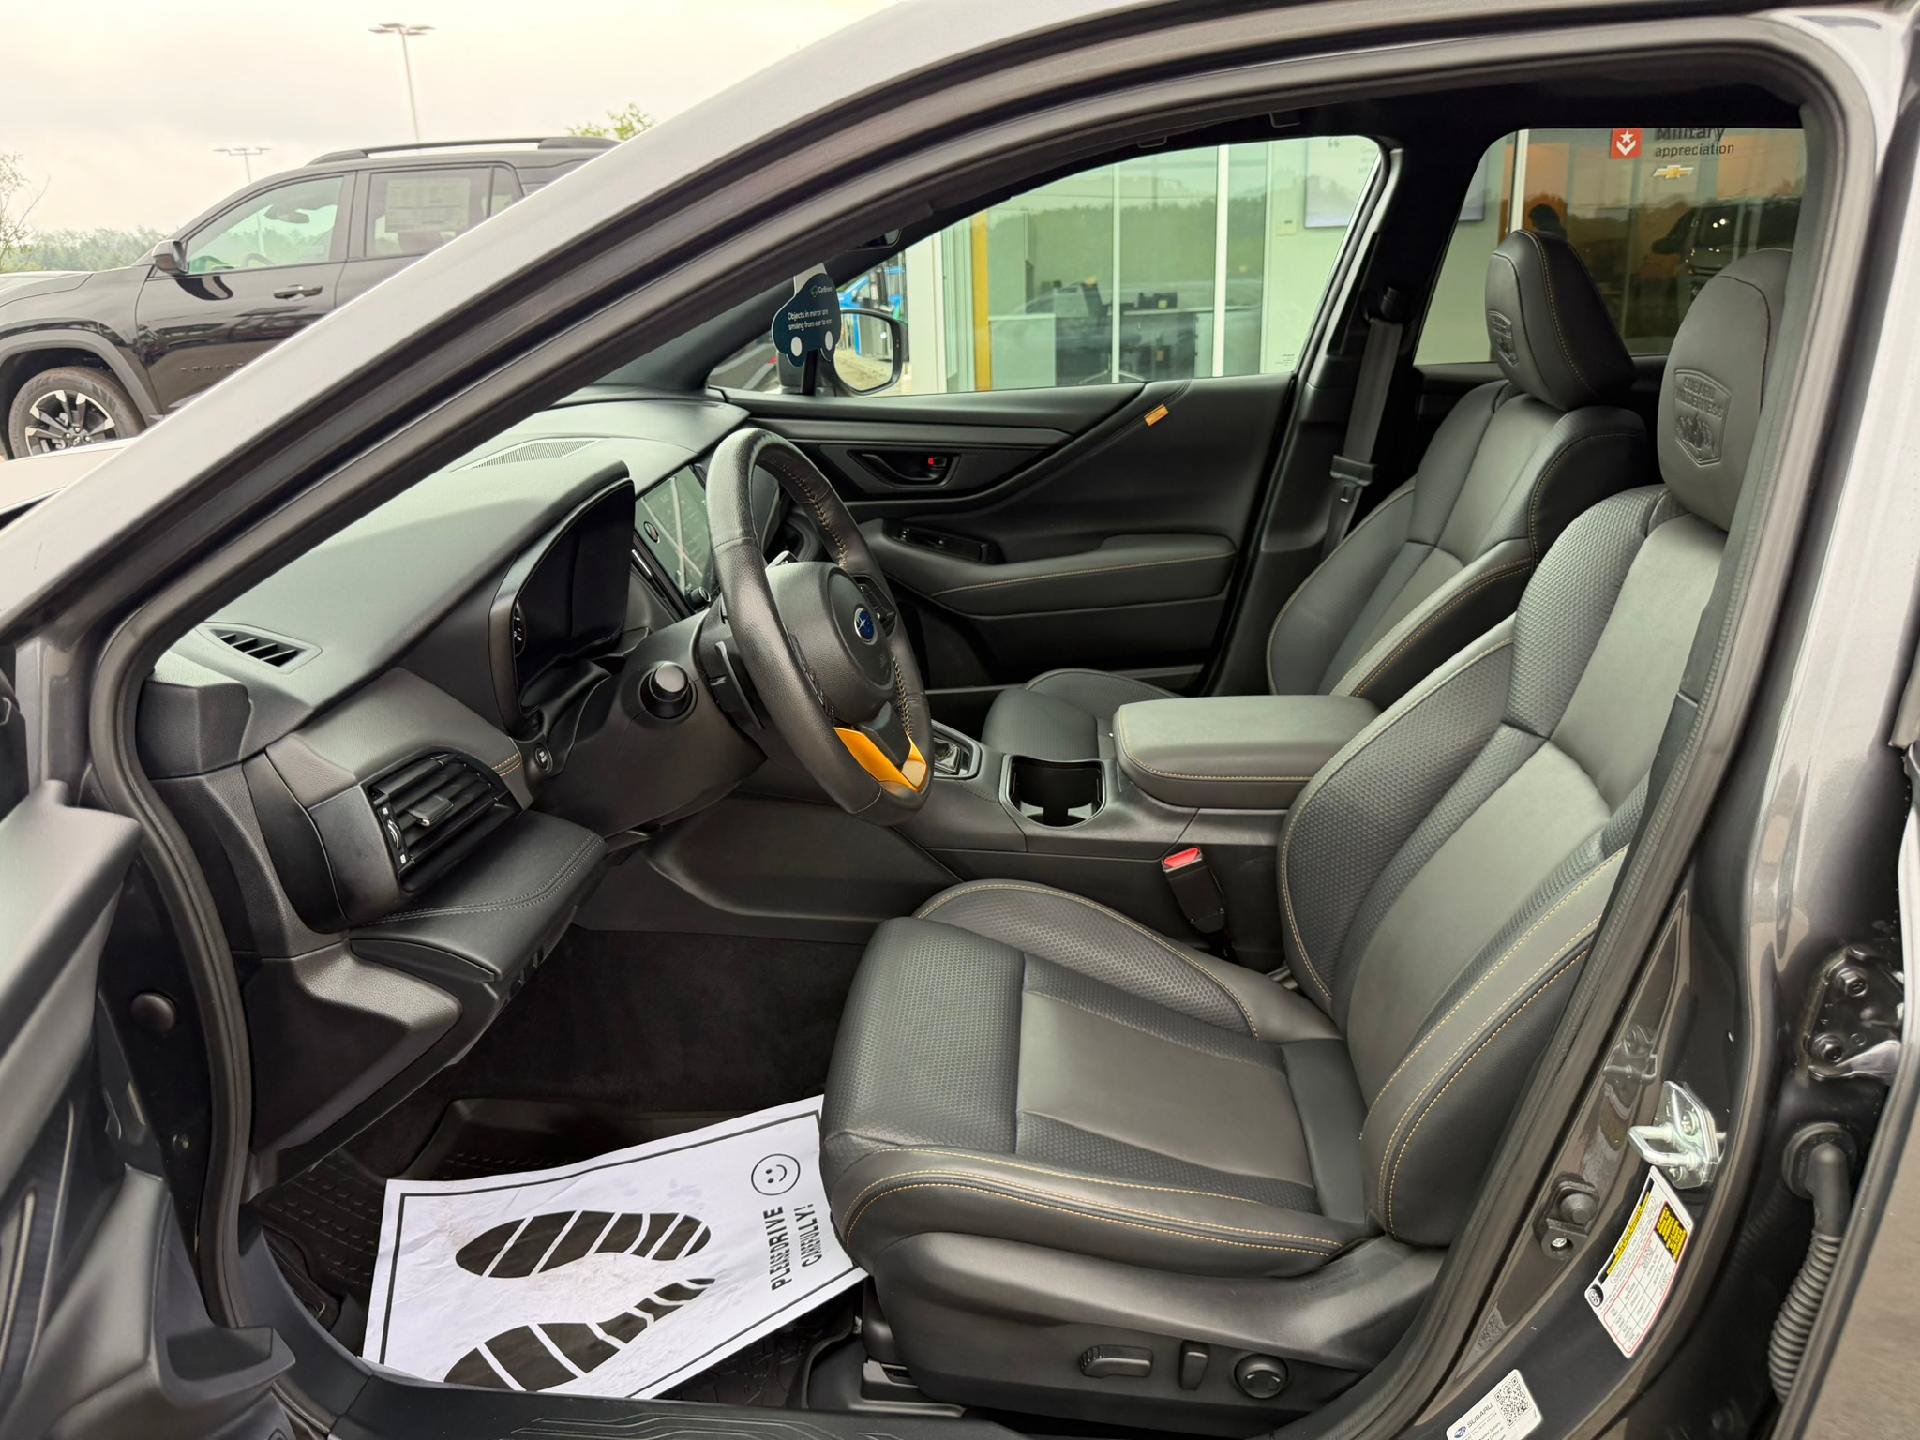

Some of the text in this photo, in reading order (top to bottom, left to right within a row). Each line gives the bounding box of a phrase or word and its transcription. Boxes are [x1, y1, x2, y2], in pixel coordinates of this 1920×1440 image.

[1655, 127, 1725, 142] Military
[1655, 143, 1734, 158] appreciation
[763, 1206, 789, 1253] DRIVE
